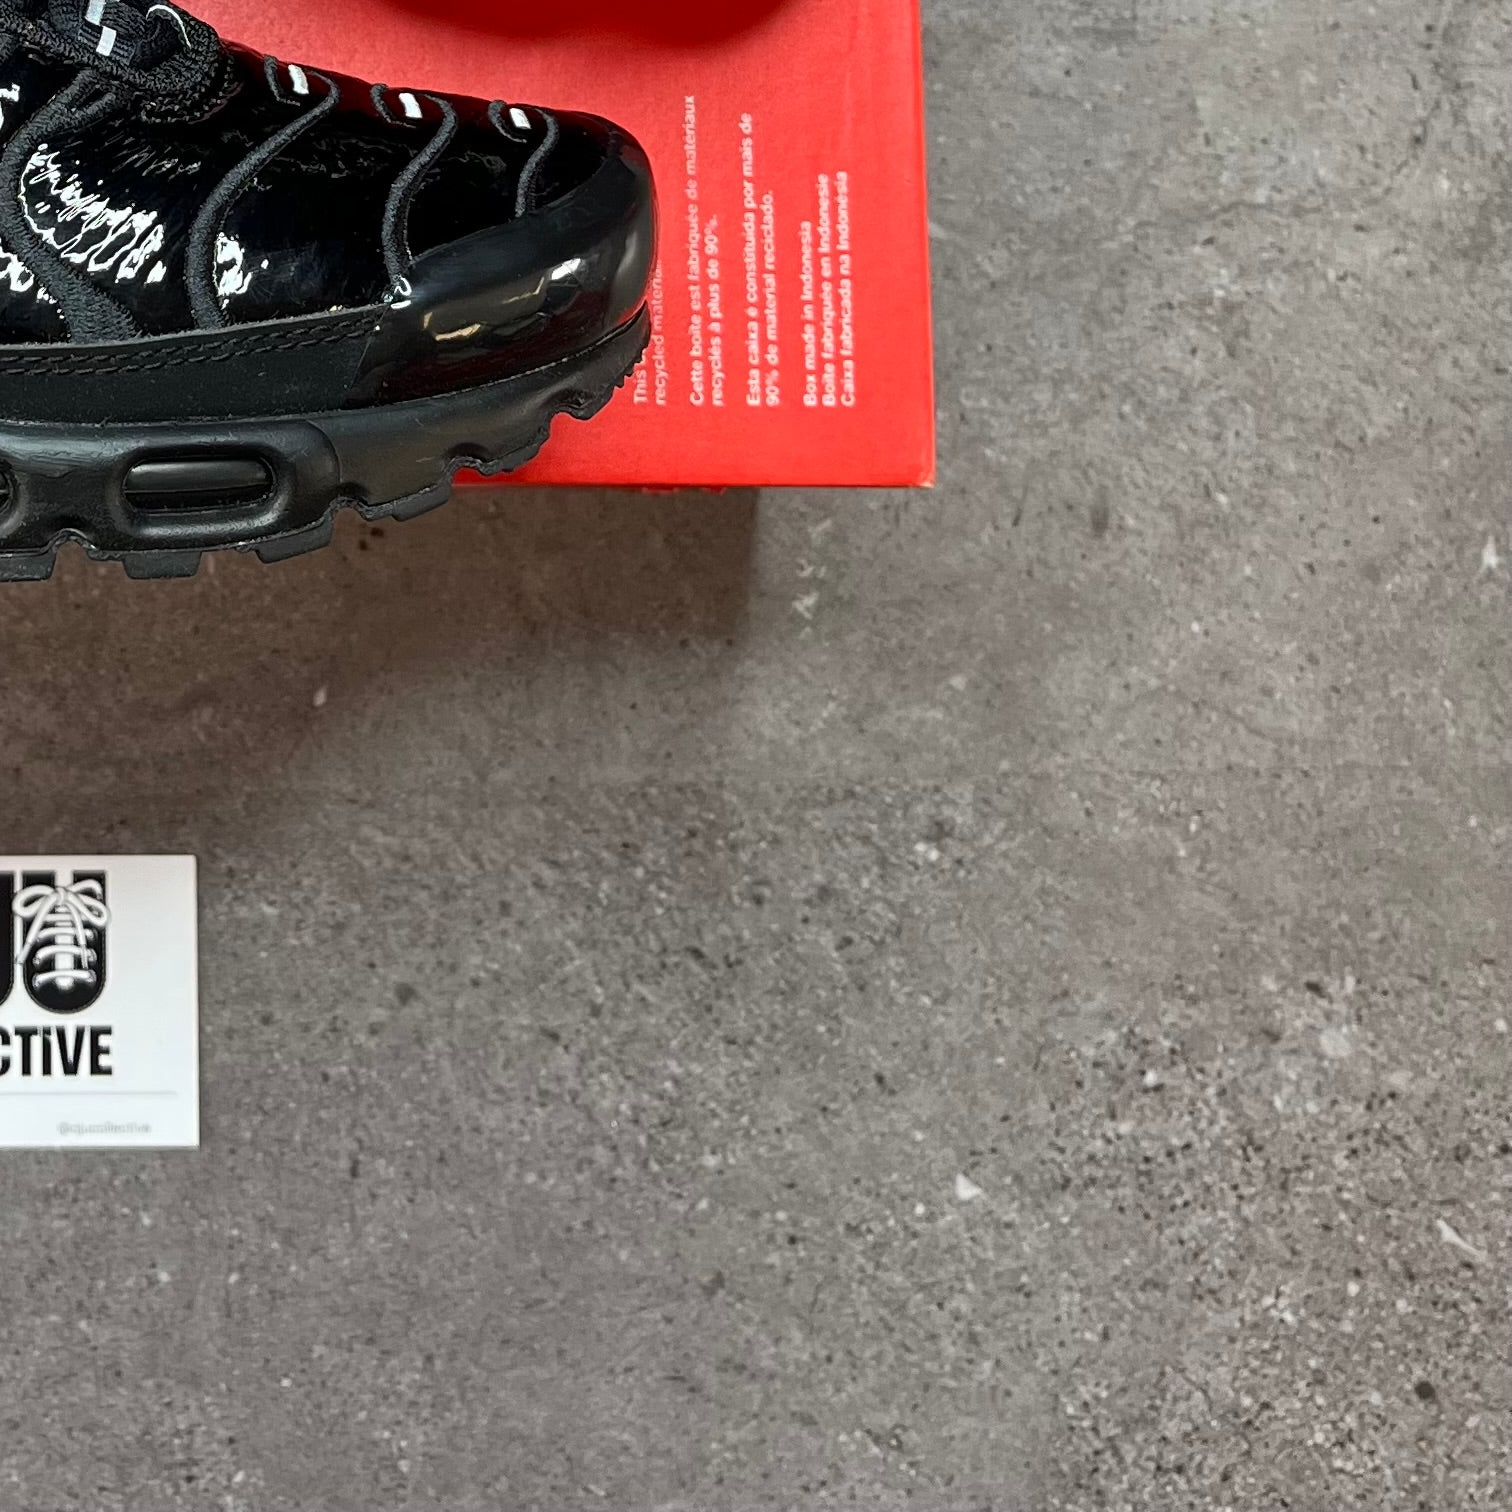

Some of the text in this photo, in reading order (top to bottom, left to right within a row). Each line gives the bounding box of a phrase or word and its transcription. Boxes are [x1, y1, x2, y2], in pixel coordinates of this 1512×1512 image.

[682, 96, 696, 175] matériaux
[738, 113, 752, 134] de
[739, 138, 752, 177] mais
[684, 179, 697, 200] de
[743, 180, 757, 209] por
[686, 204, 702, 280] fabriquée
[707, 258, 719, 280] de
[821, 256, 832, 278] en
[839, 254, 851, 275] na
[688, 286, 702, 312] est
[706, 284, 722, 318] plus
[744, 306, 758, 318] é
[759, 190, 779, 406] 90% de material reciclado.
[798, 221, 816, 406] Box made in Indonesia
[838, 278, 853, 356] fabricada
[708, 322, 720, 332] à
[818, 282, 835, 359] fabriquée
[744, 321, 758, 365] caixa
[634, 370, 647, 404] This
[652, 334, 668, 405] recycled
[690, 360, 704, 405] Cette
[708, 336, 724, 406] recyclés
[746, 369, 760, 406] Esta
[840, 360, 854, 406] Caixa
